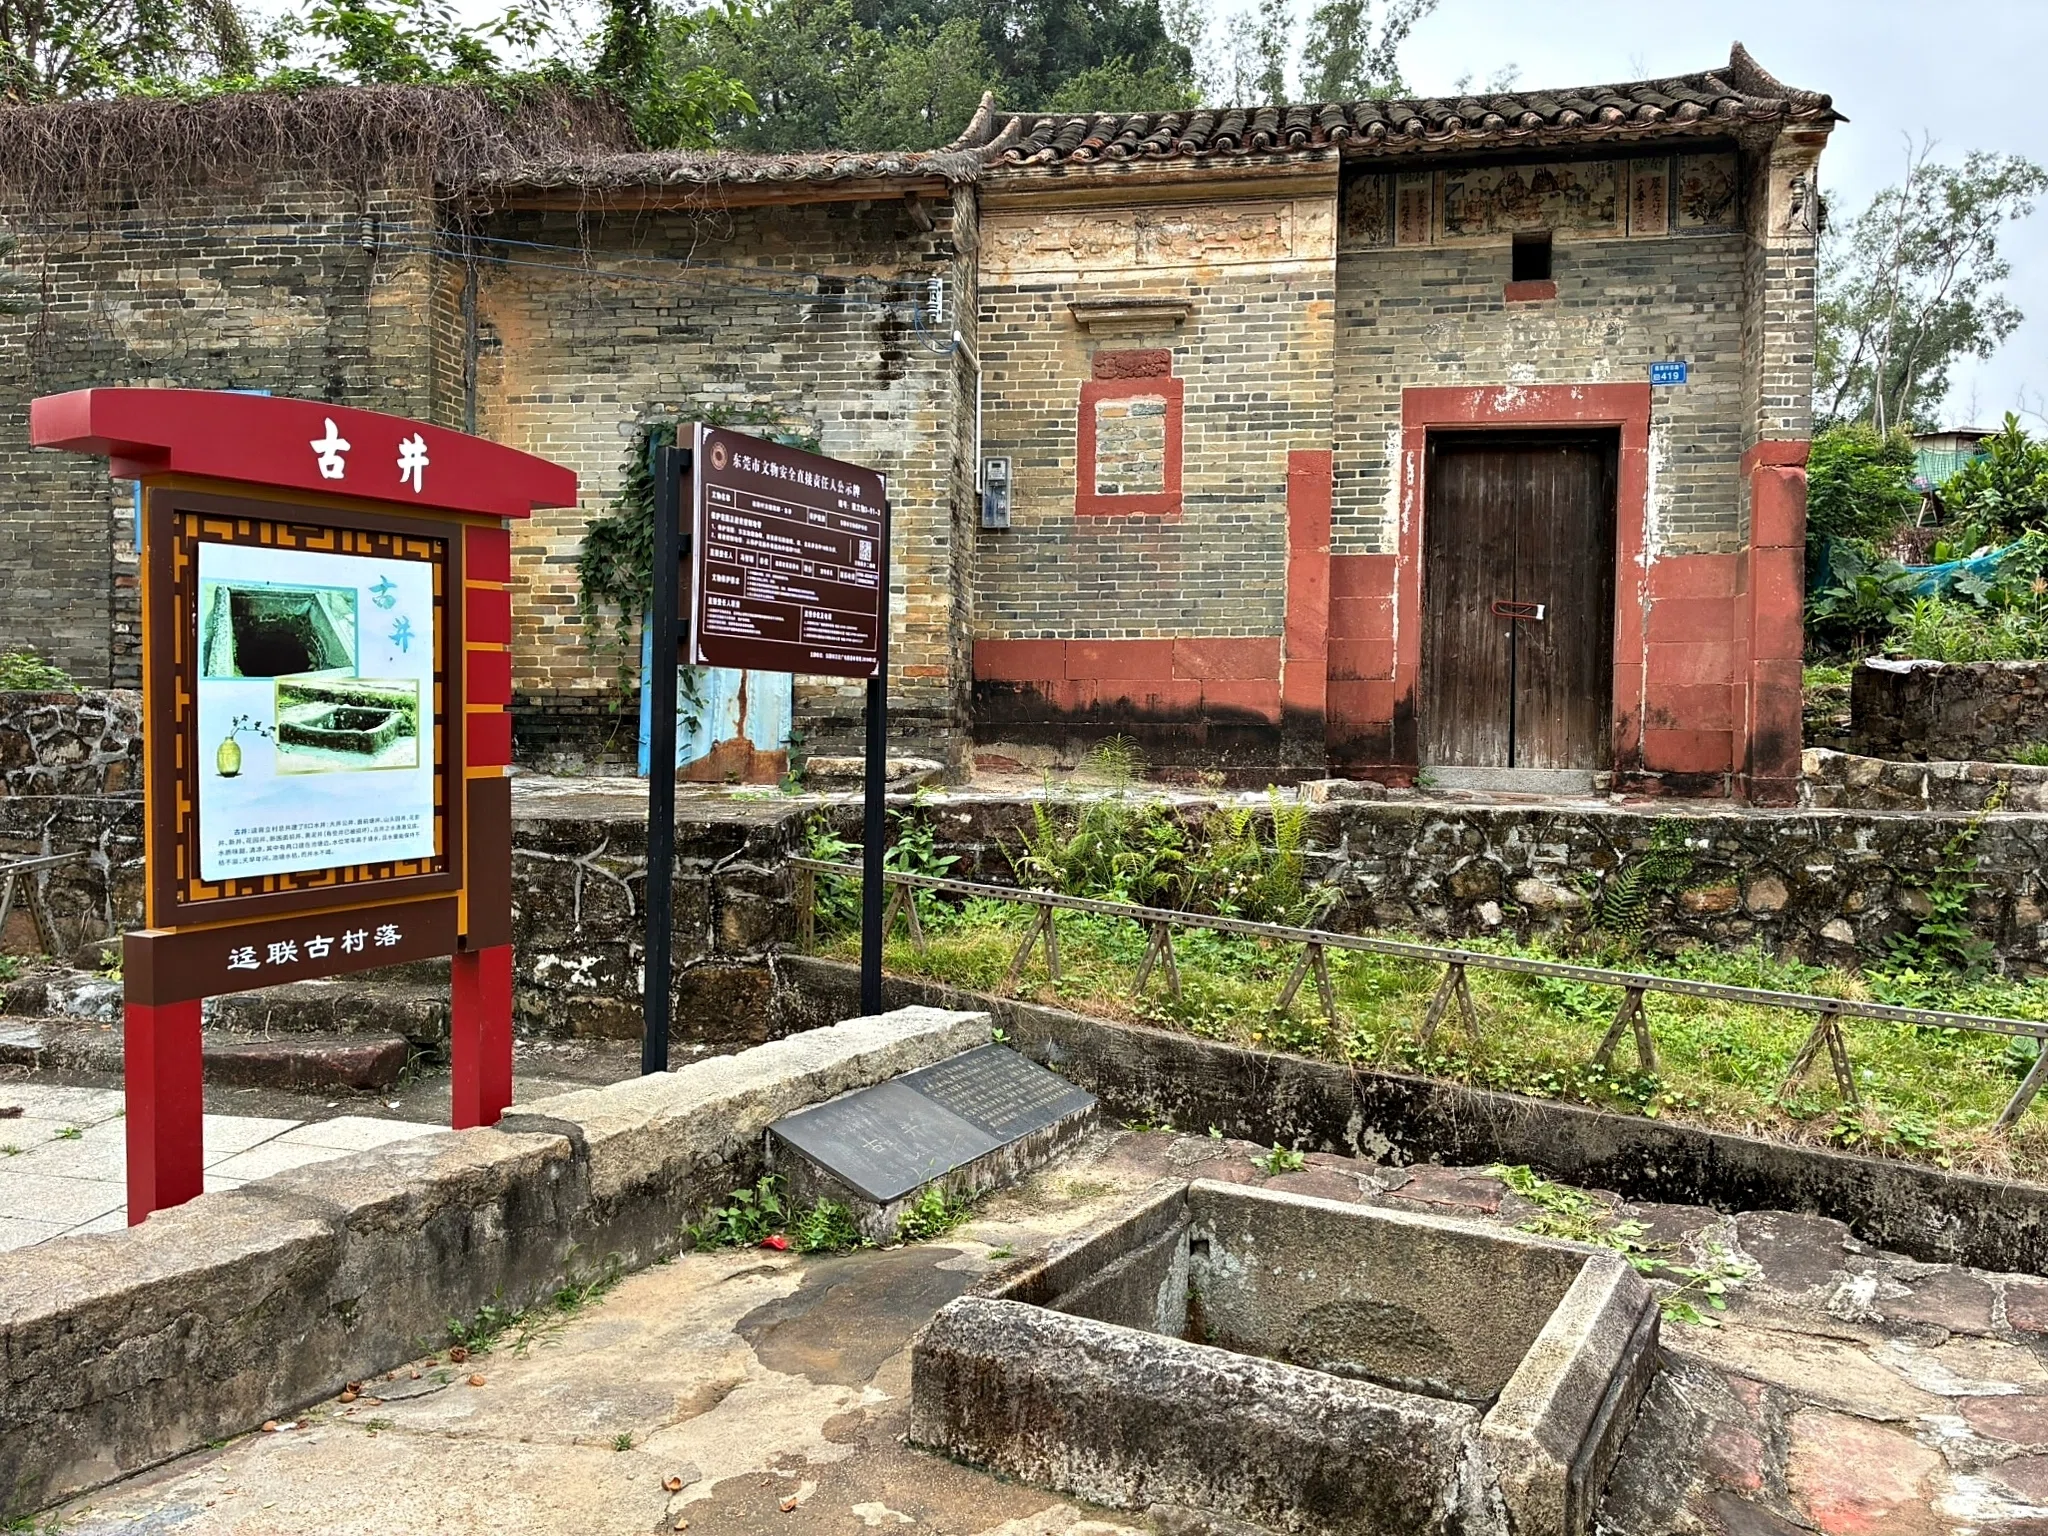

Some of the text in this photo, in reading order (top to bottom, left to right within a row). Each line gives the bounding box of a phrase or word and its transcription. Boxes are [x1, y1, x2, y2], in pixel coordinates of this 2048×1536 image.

[309, 417, 430, 493] 古井
[732, 452, 861, 499] 东莞市文物安全直接责任人公示牌
[368, 574, 415, 653] 古井
[226, 924, 403, 971] 迳联古村落
